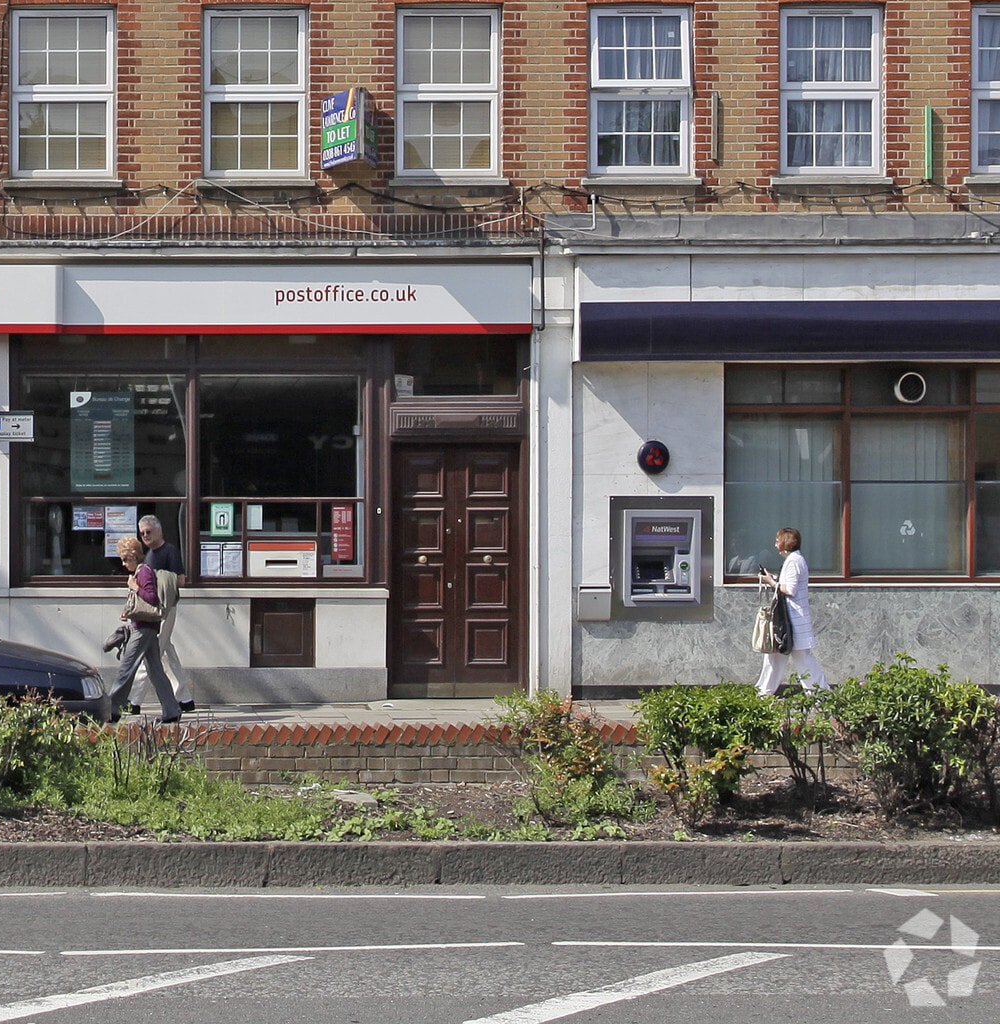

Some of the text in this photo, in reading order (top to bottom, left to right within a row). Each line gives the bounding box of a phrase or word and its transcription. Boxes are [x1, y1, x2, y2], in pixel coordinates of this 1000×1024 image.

[327, 130, 336, 144] TO
[337, 126, 351, 140] LET
[274, 285, 417, 306] postoffice.co.uk
